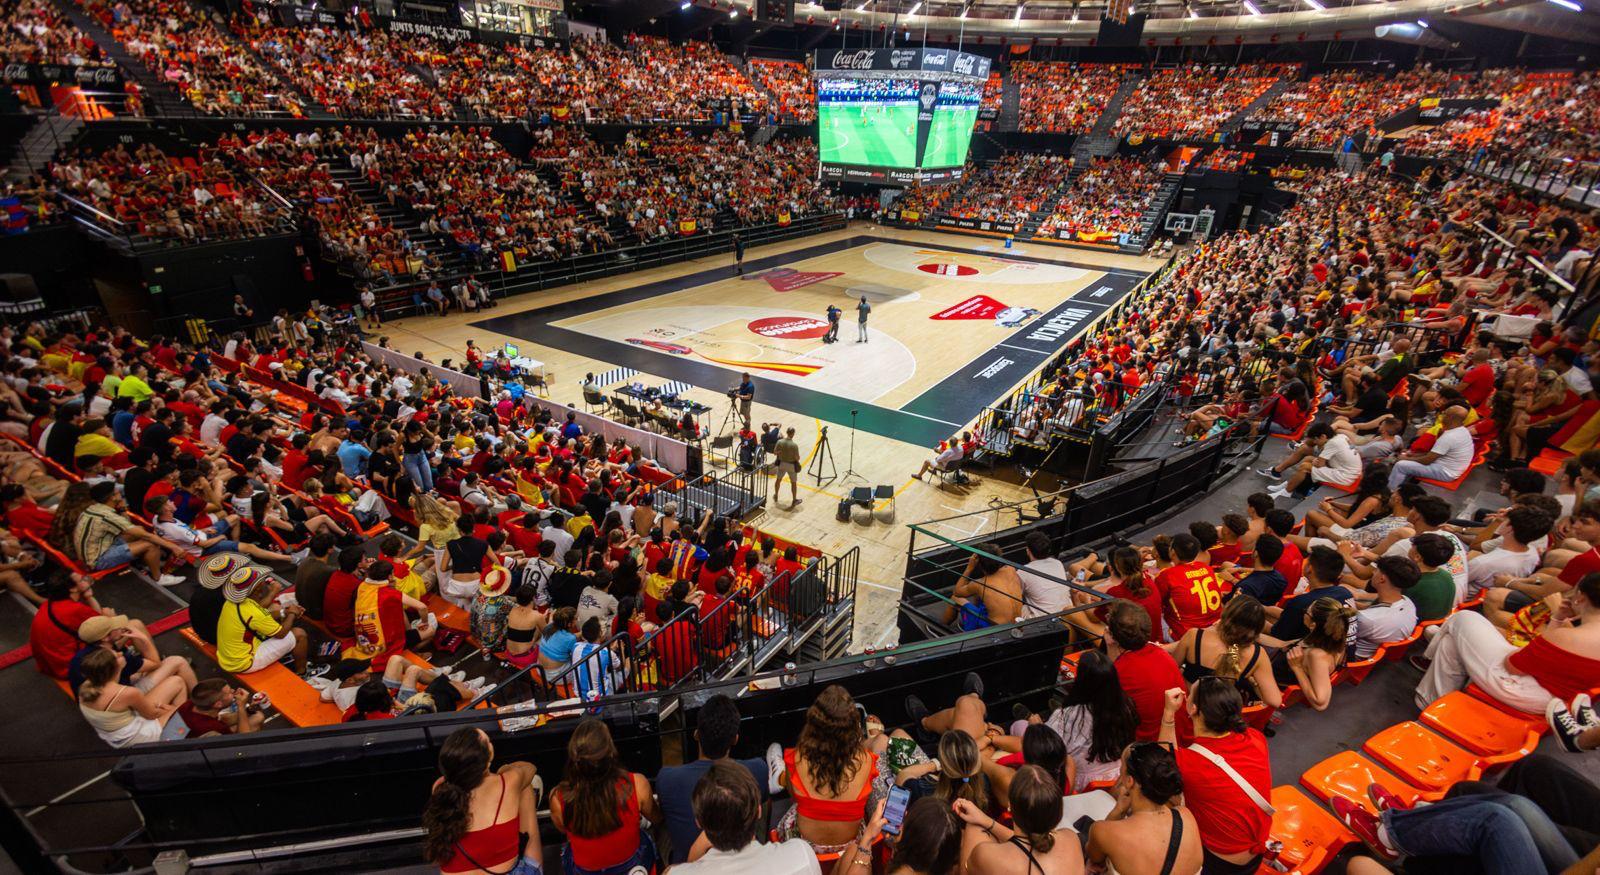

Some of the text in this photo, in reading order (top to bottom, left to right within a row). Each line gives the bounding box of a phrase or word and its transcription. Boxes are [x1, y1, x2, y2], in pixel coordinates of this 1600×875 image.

[390, 21, 414, 33] JUNTS
[415, 24, 431, 34] SOM
[832, 50, 875, 70] Coca-Cola
[1026, 307, 1093, 341] VALENCIA
[524, 567, 541, 588] 18
[1190, 576, 1221, 614] 16
